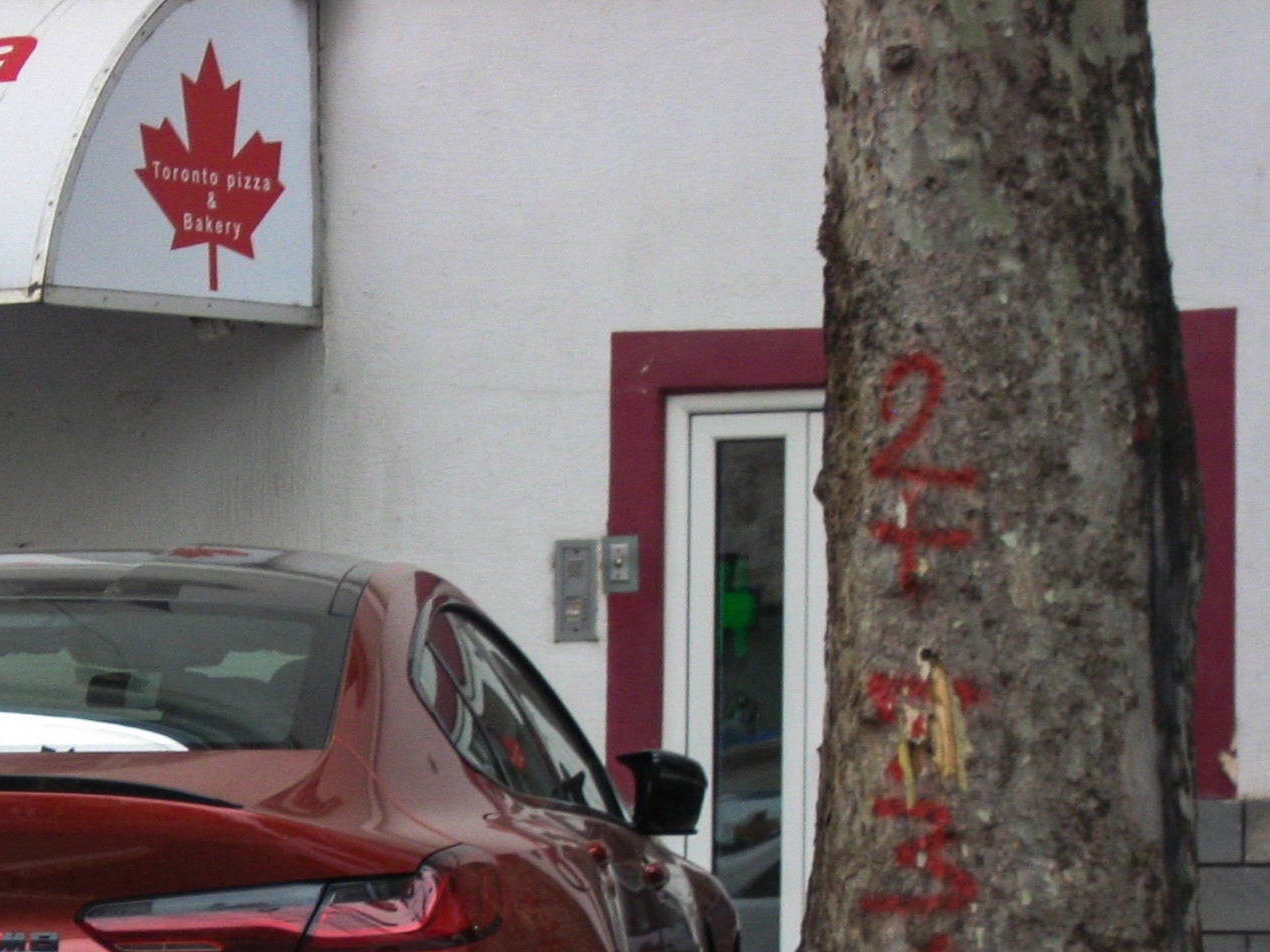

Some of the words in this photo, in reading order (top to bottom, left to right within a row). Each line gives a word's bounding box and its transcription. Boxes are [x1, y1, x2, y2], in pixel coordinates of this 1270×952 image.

[152, 160, 218, 186] Toronto
[227, 171, 271, 192] pizza
[207, 190, 217, 209] &
[183, 213, 242, 240] Bakery
